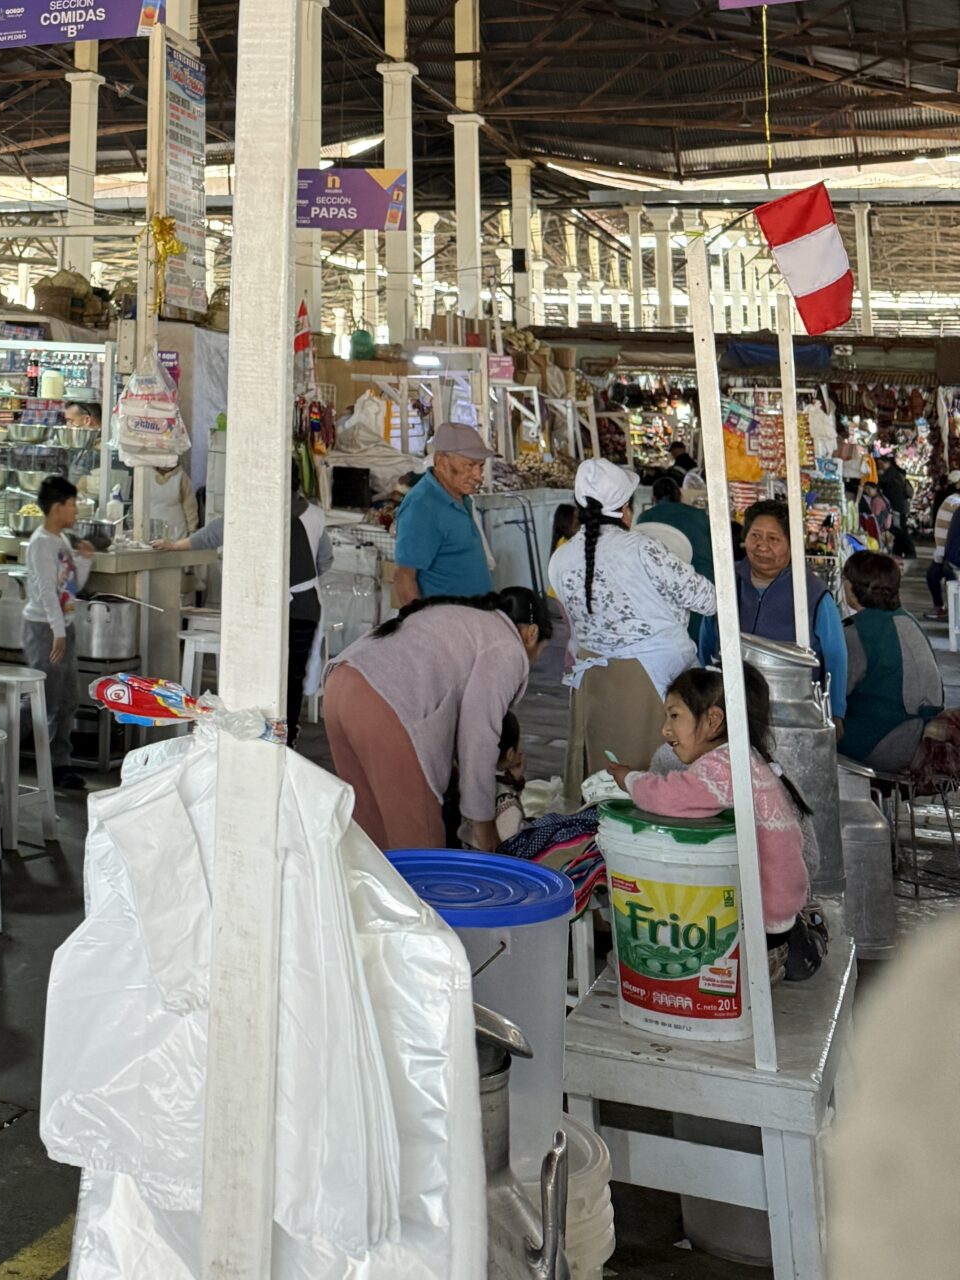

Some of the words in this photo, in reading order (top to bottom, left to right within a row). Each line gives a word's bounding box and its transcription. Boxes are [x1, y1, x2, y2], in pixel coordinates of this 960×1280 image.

[40, 8, 106, 25] COMIDAS
[315, 196, 352, 205] SECCIÓN
[310, 206, 358, 219] PAPAS
[625, 900, 718, 951] Friol
[718, 998, 731, 1011] 20
